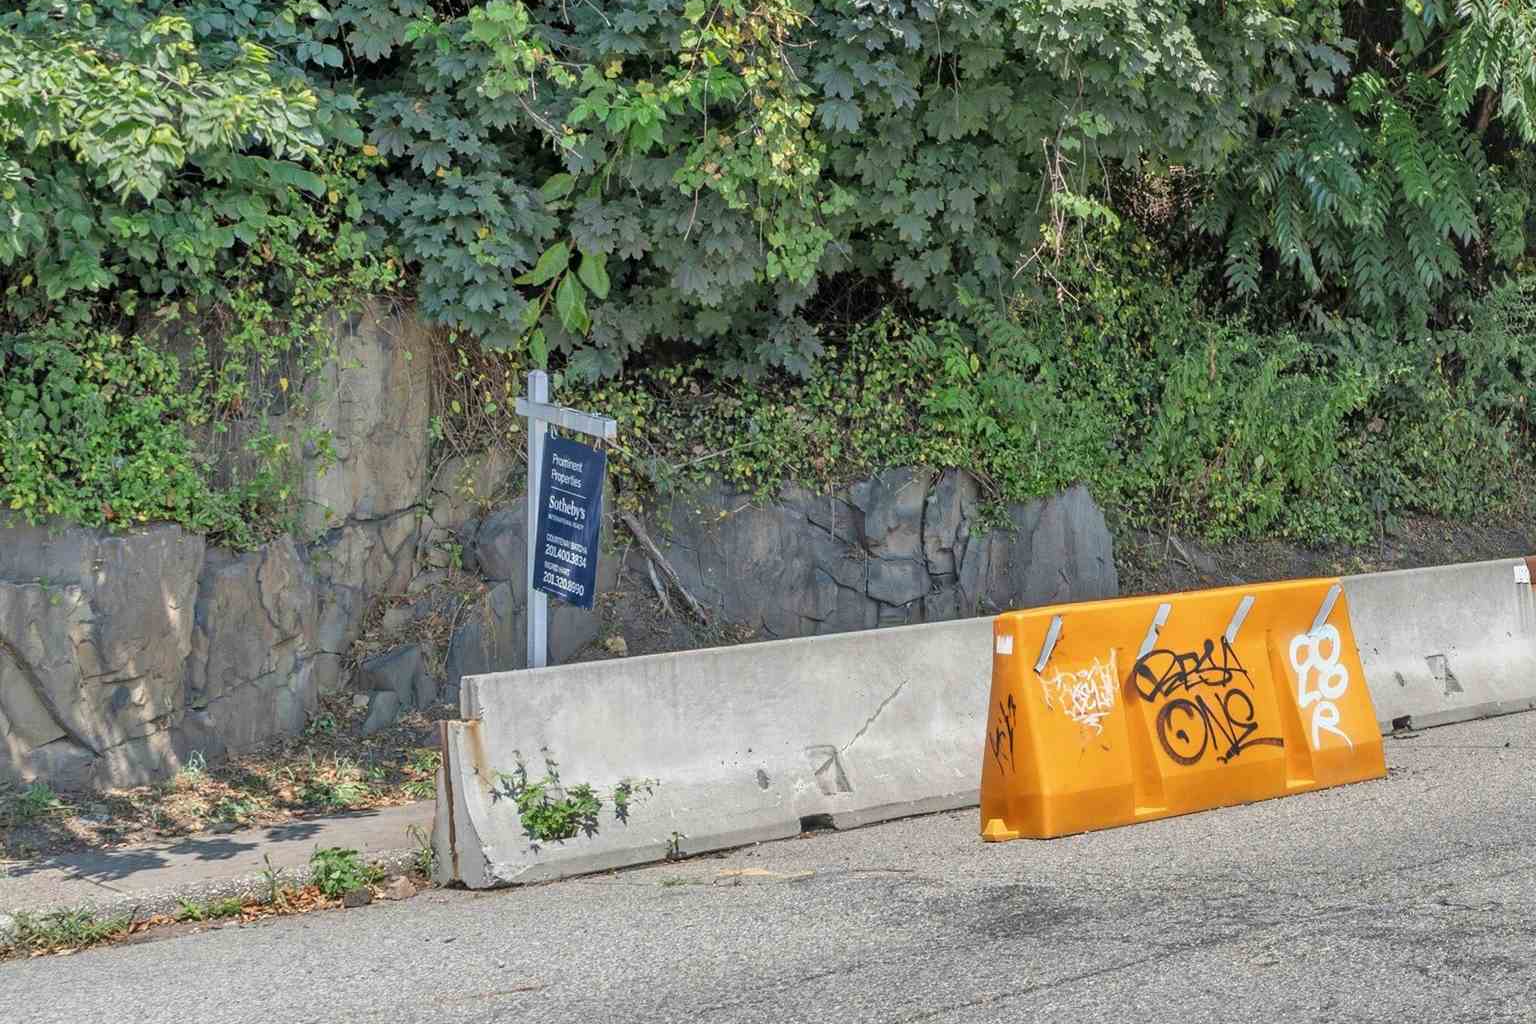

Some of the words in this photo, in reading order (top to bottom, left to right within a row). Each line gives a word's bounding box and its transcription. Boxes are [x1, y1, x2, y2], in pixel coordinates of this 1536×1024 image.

[552, 453, 583, 473] Prominent
[551, 468, 582, 488] Properties
[548, 495, 586, 521] Sotheby's
